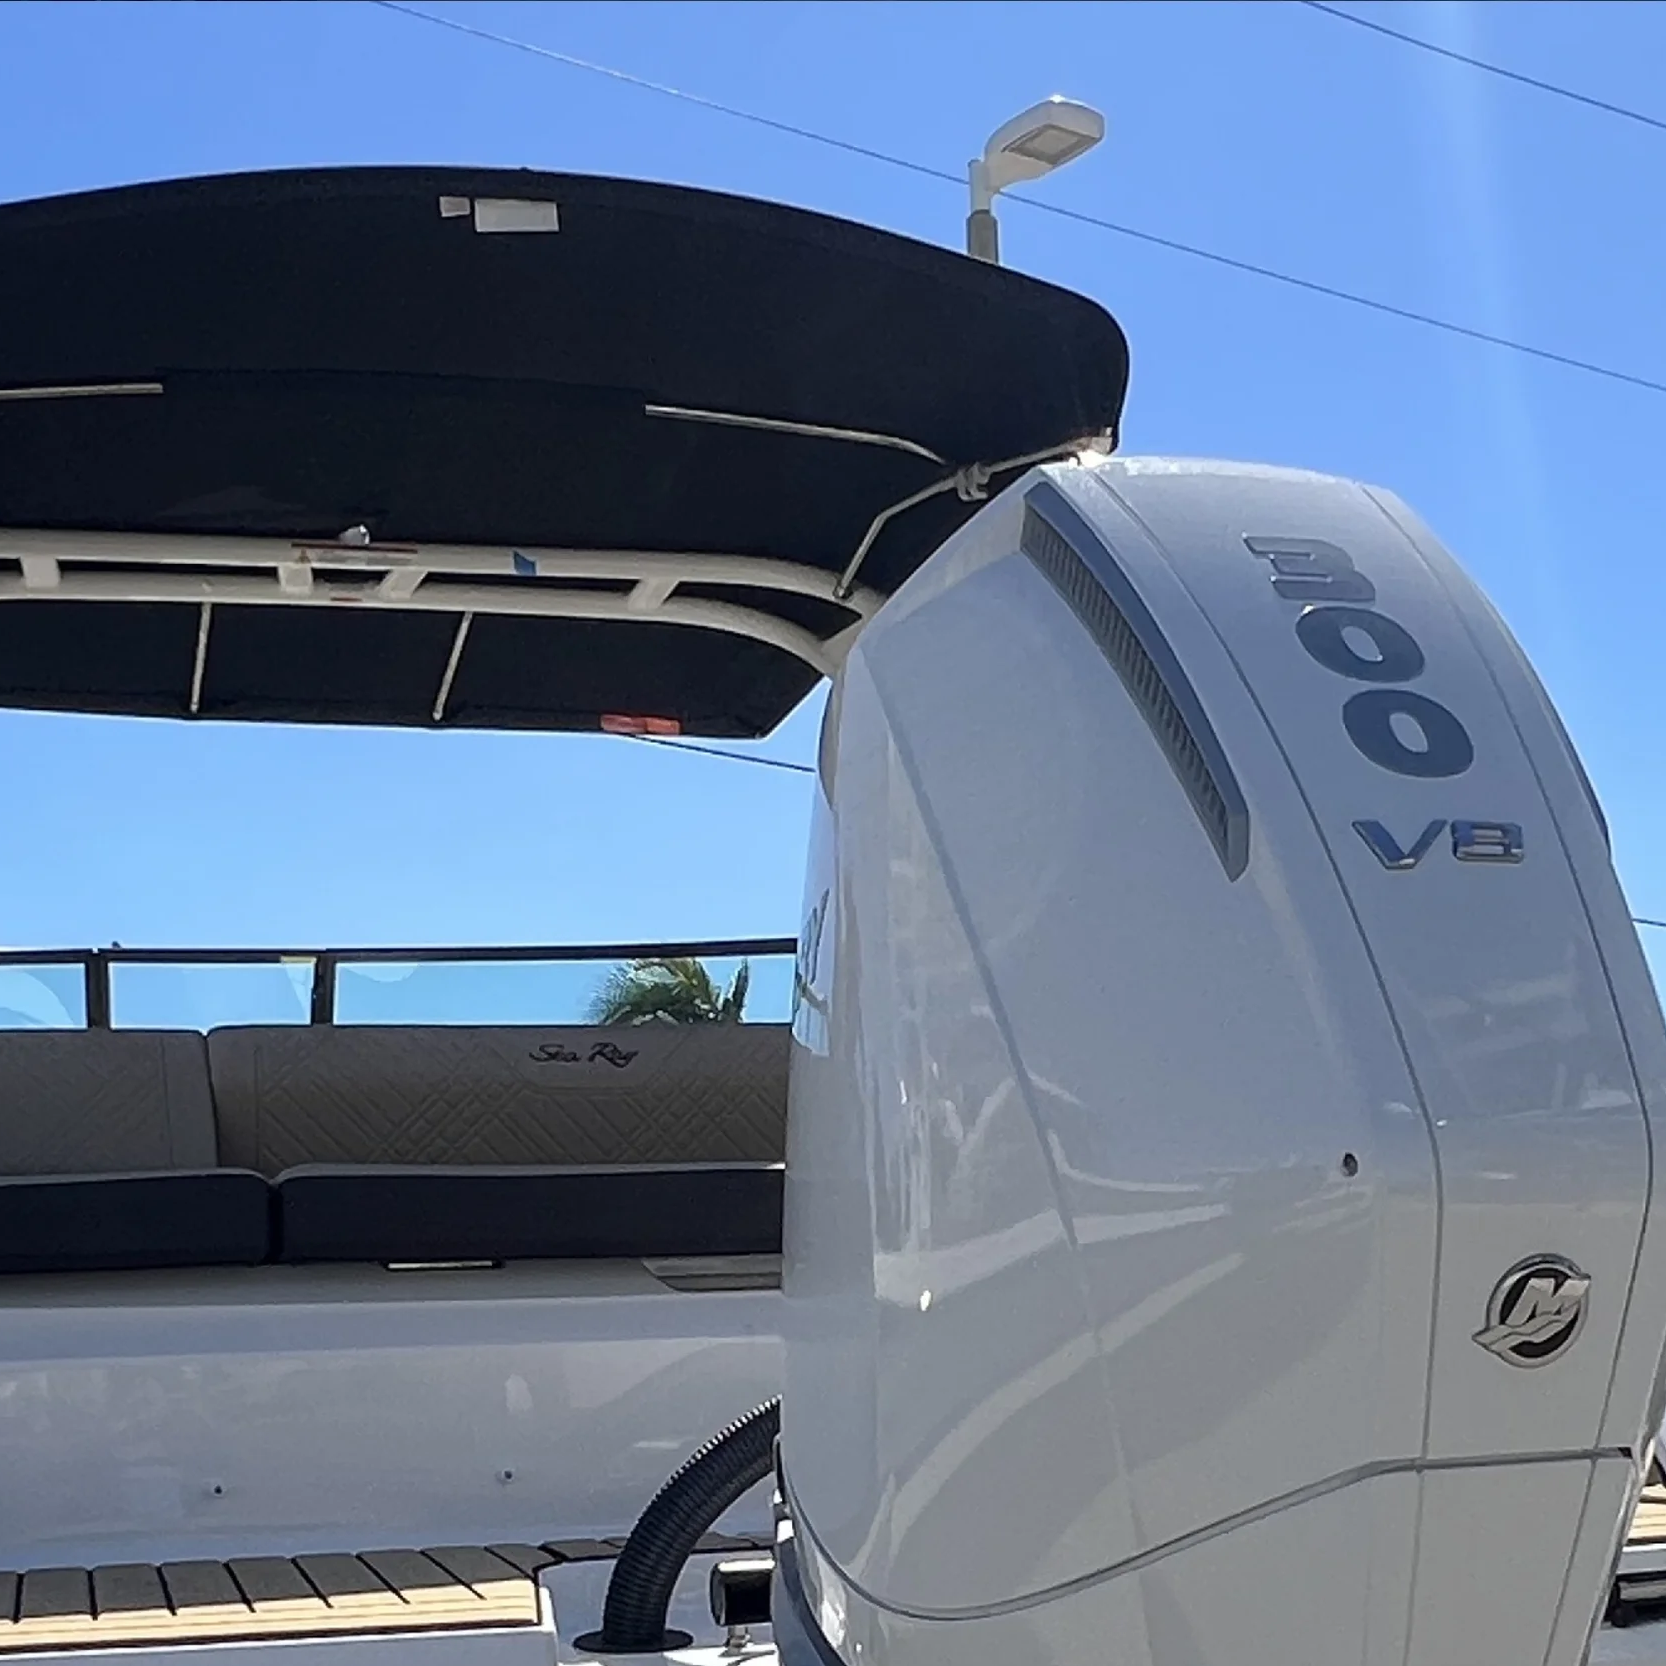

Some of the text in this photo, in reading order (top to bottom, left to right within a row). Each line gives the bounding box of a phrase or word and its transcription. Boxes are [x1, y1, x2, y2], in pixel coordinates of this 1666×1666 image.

[1241, 533, 1475, 780] 300
[1351, 818, 1525, 871] V8
[529, 1043, 581, 1064] Sea
